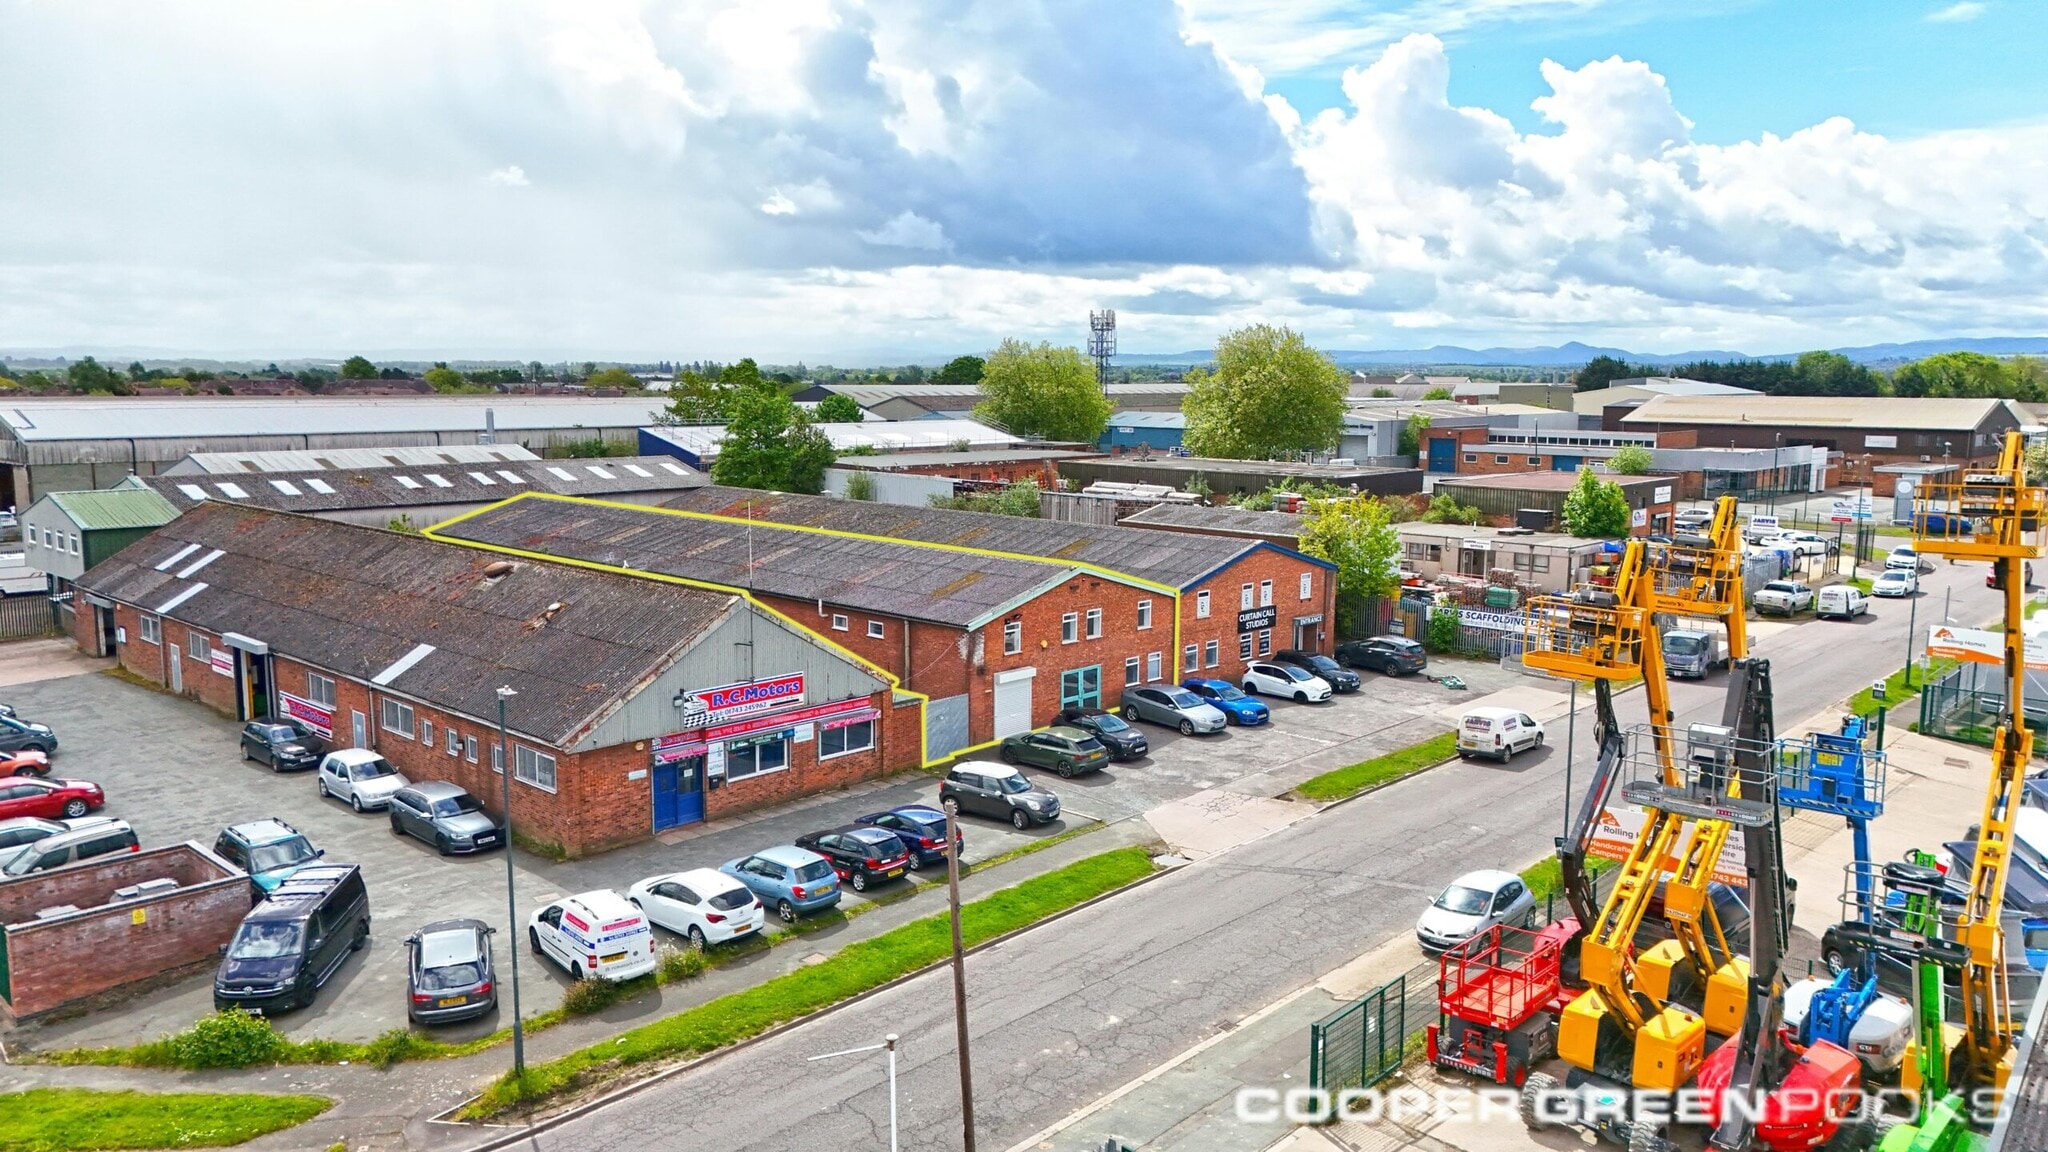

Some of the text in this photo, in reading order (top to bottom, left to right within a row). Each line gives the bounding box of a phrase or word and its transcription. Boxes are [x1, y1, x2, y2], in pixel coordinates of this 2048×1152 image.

[1239, 608, 1275, 622] CURTAIN CALL
[1300, 616, 1322, 625] ENTRANCE
[1465, 611, 1528, 626] SCAFFOLDING
[1246, 618, 1269, 629] STUDIOS
[713, 681, 800, 707] R.C.Motors
[713, 702, 767, 719] Tel: 01743 245962
[1603, 825, 1634, 839] Rolling
[1590, 840, 1632, 853] Handcrafte
[1590, 848, 1623, 860] Campers
